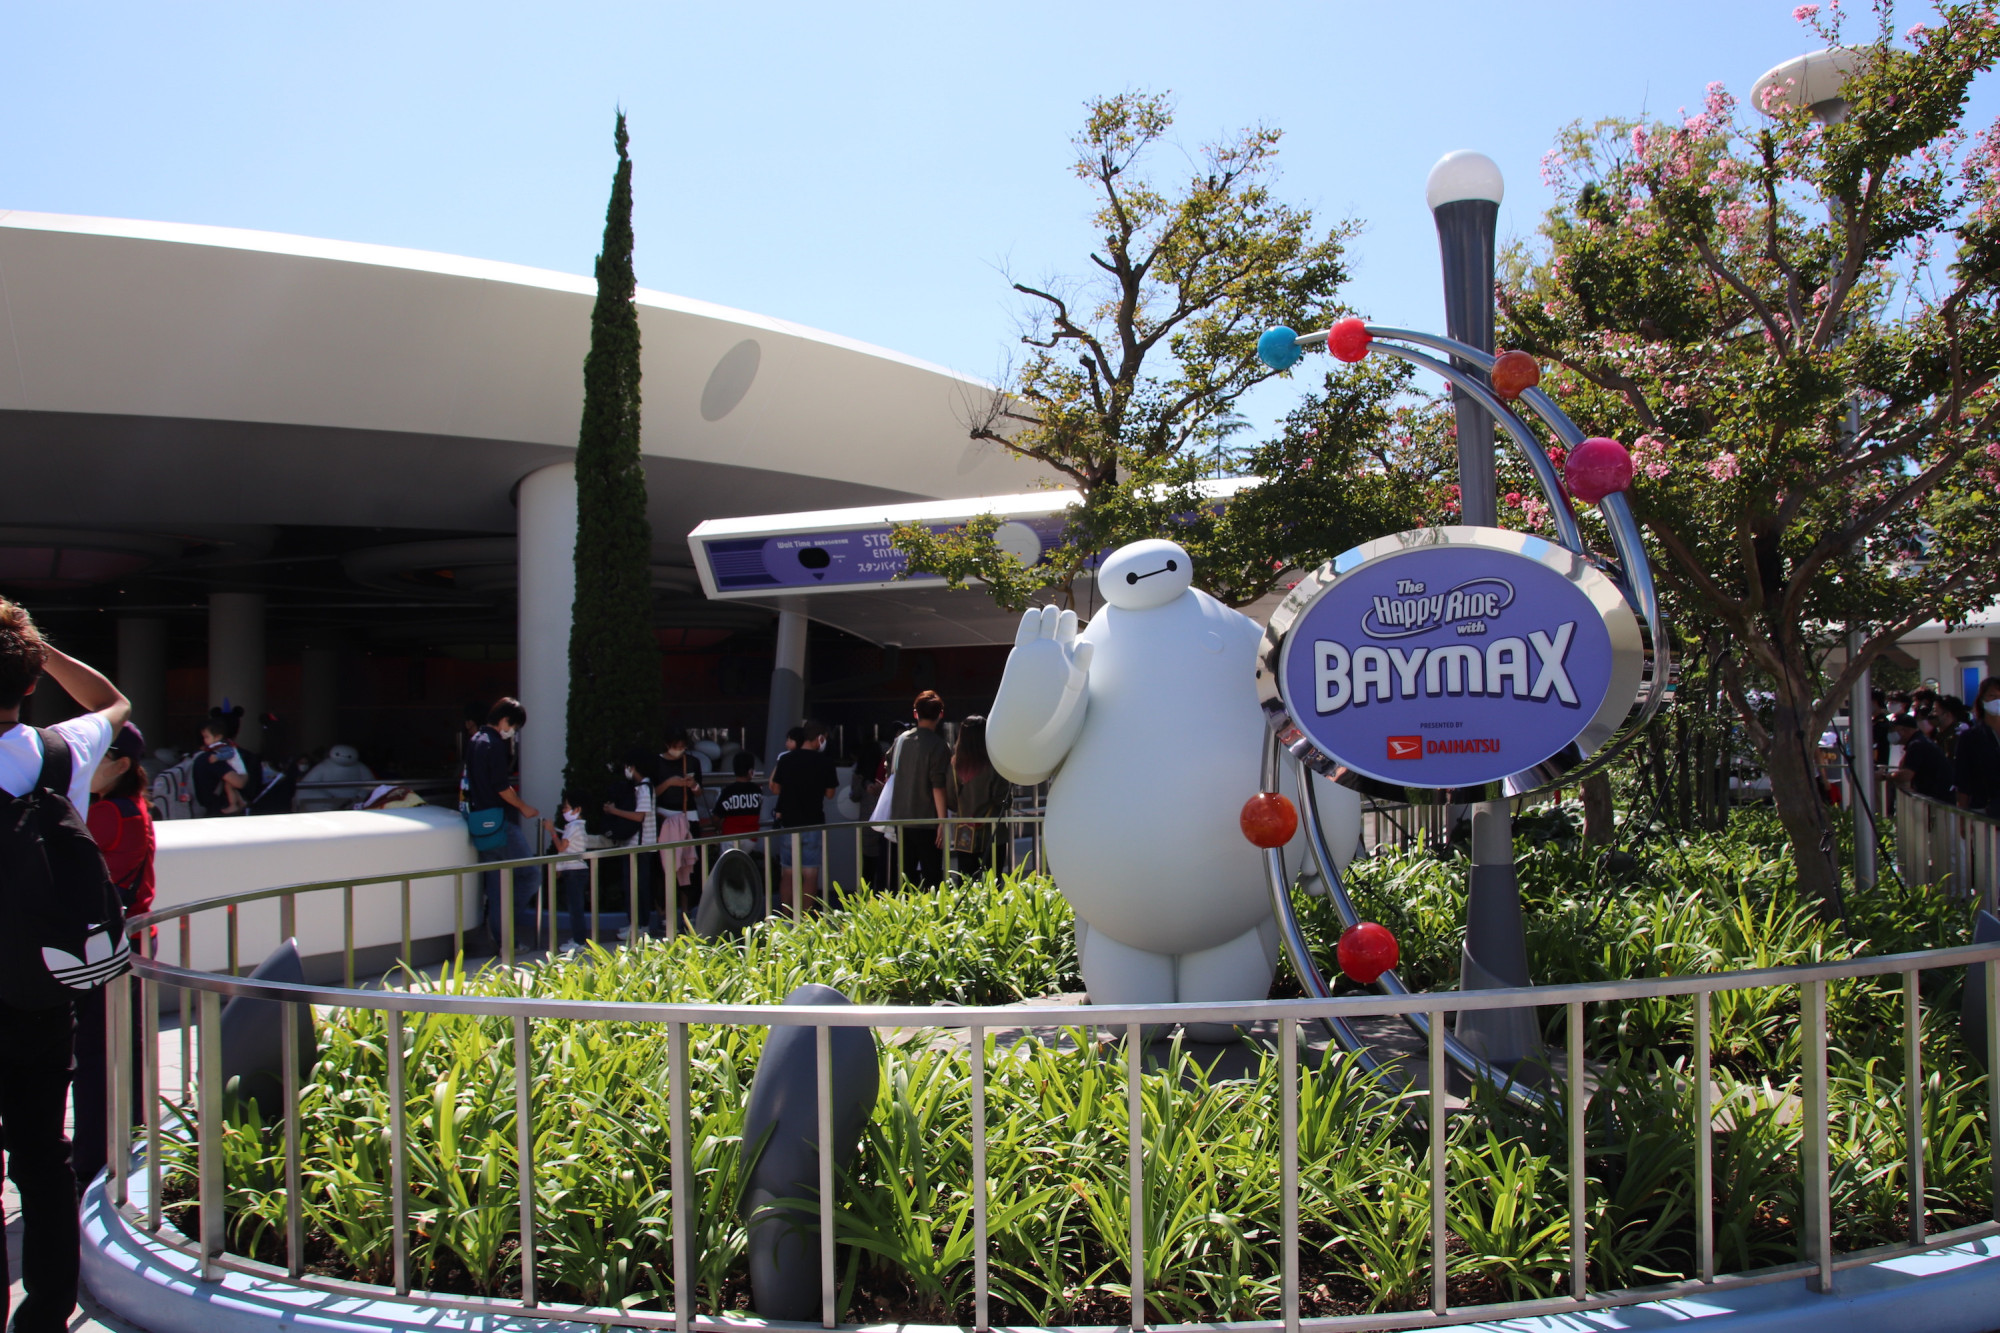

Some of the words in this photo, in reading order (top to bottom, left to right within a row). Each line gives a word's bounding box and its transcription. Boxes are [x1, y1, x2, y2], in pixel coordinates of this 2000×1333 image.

[1396, 579, 1425, 595] The
[1456, 620, 1486, 634] with
[1314, 621, 1579, 714] BAYMAX
[1426, 738, 1500, 754] DAIHATSU
